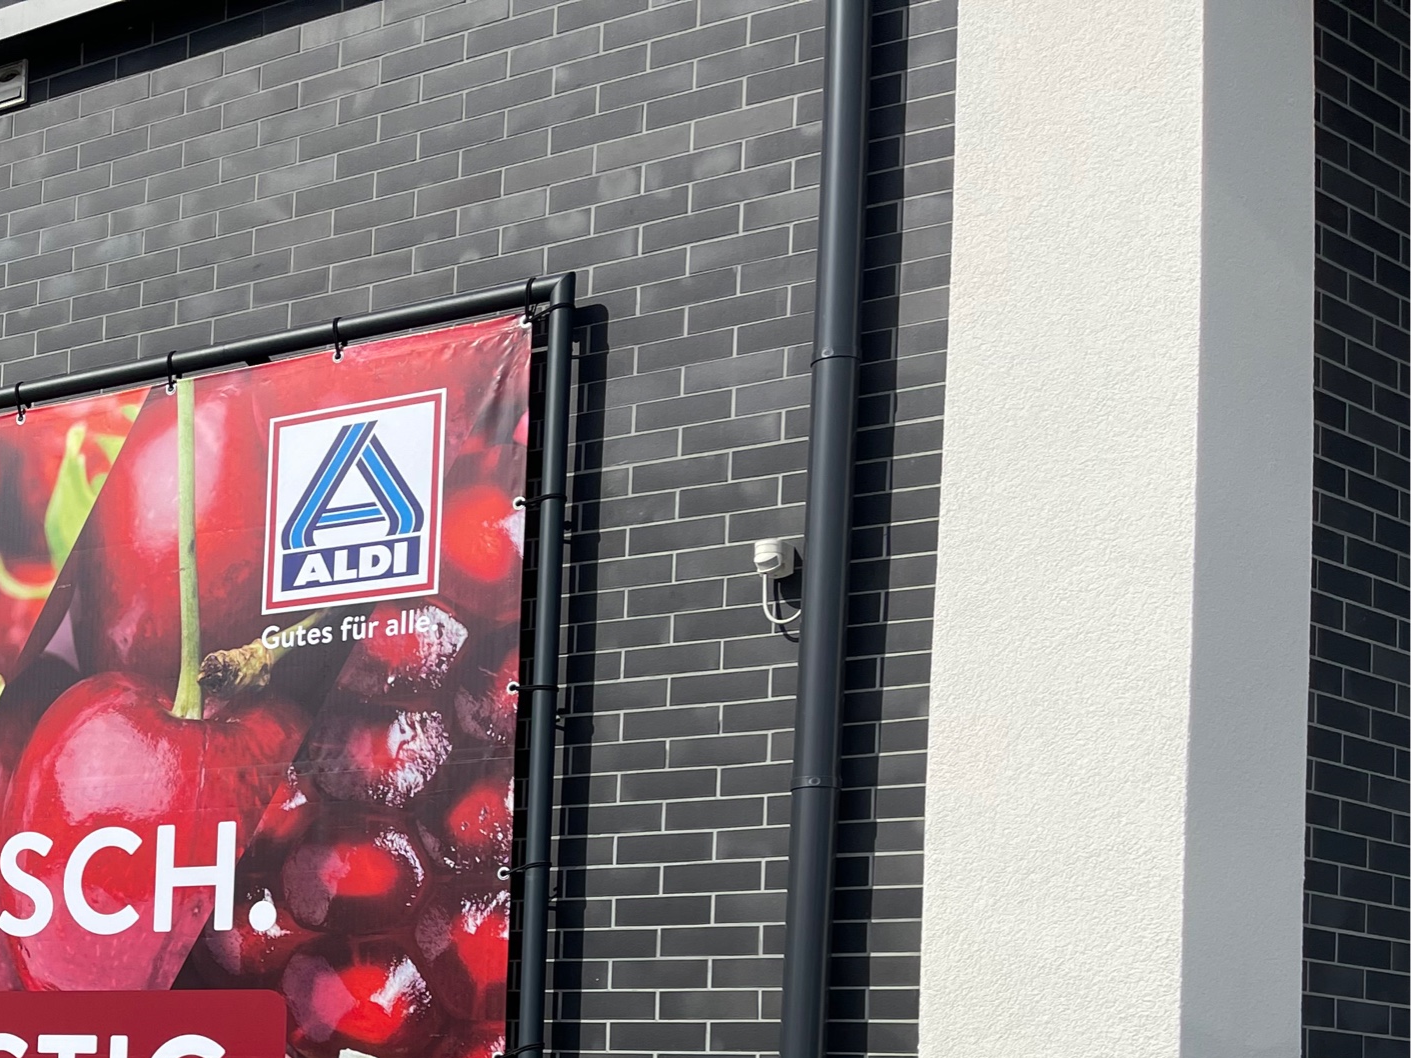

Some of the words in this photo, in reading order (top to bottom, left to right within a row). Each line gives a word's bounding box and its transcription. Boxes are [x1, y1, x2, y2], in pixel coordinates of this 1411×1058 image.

[293, 540, 409, 587] ALDI
[261, 624, 333, 650] Gutes
[340, 615, 379, 642] für
[385, 608, 438, 637] alle.
